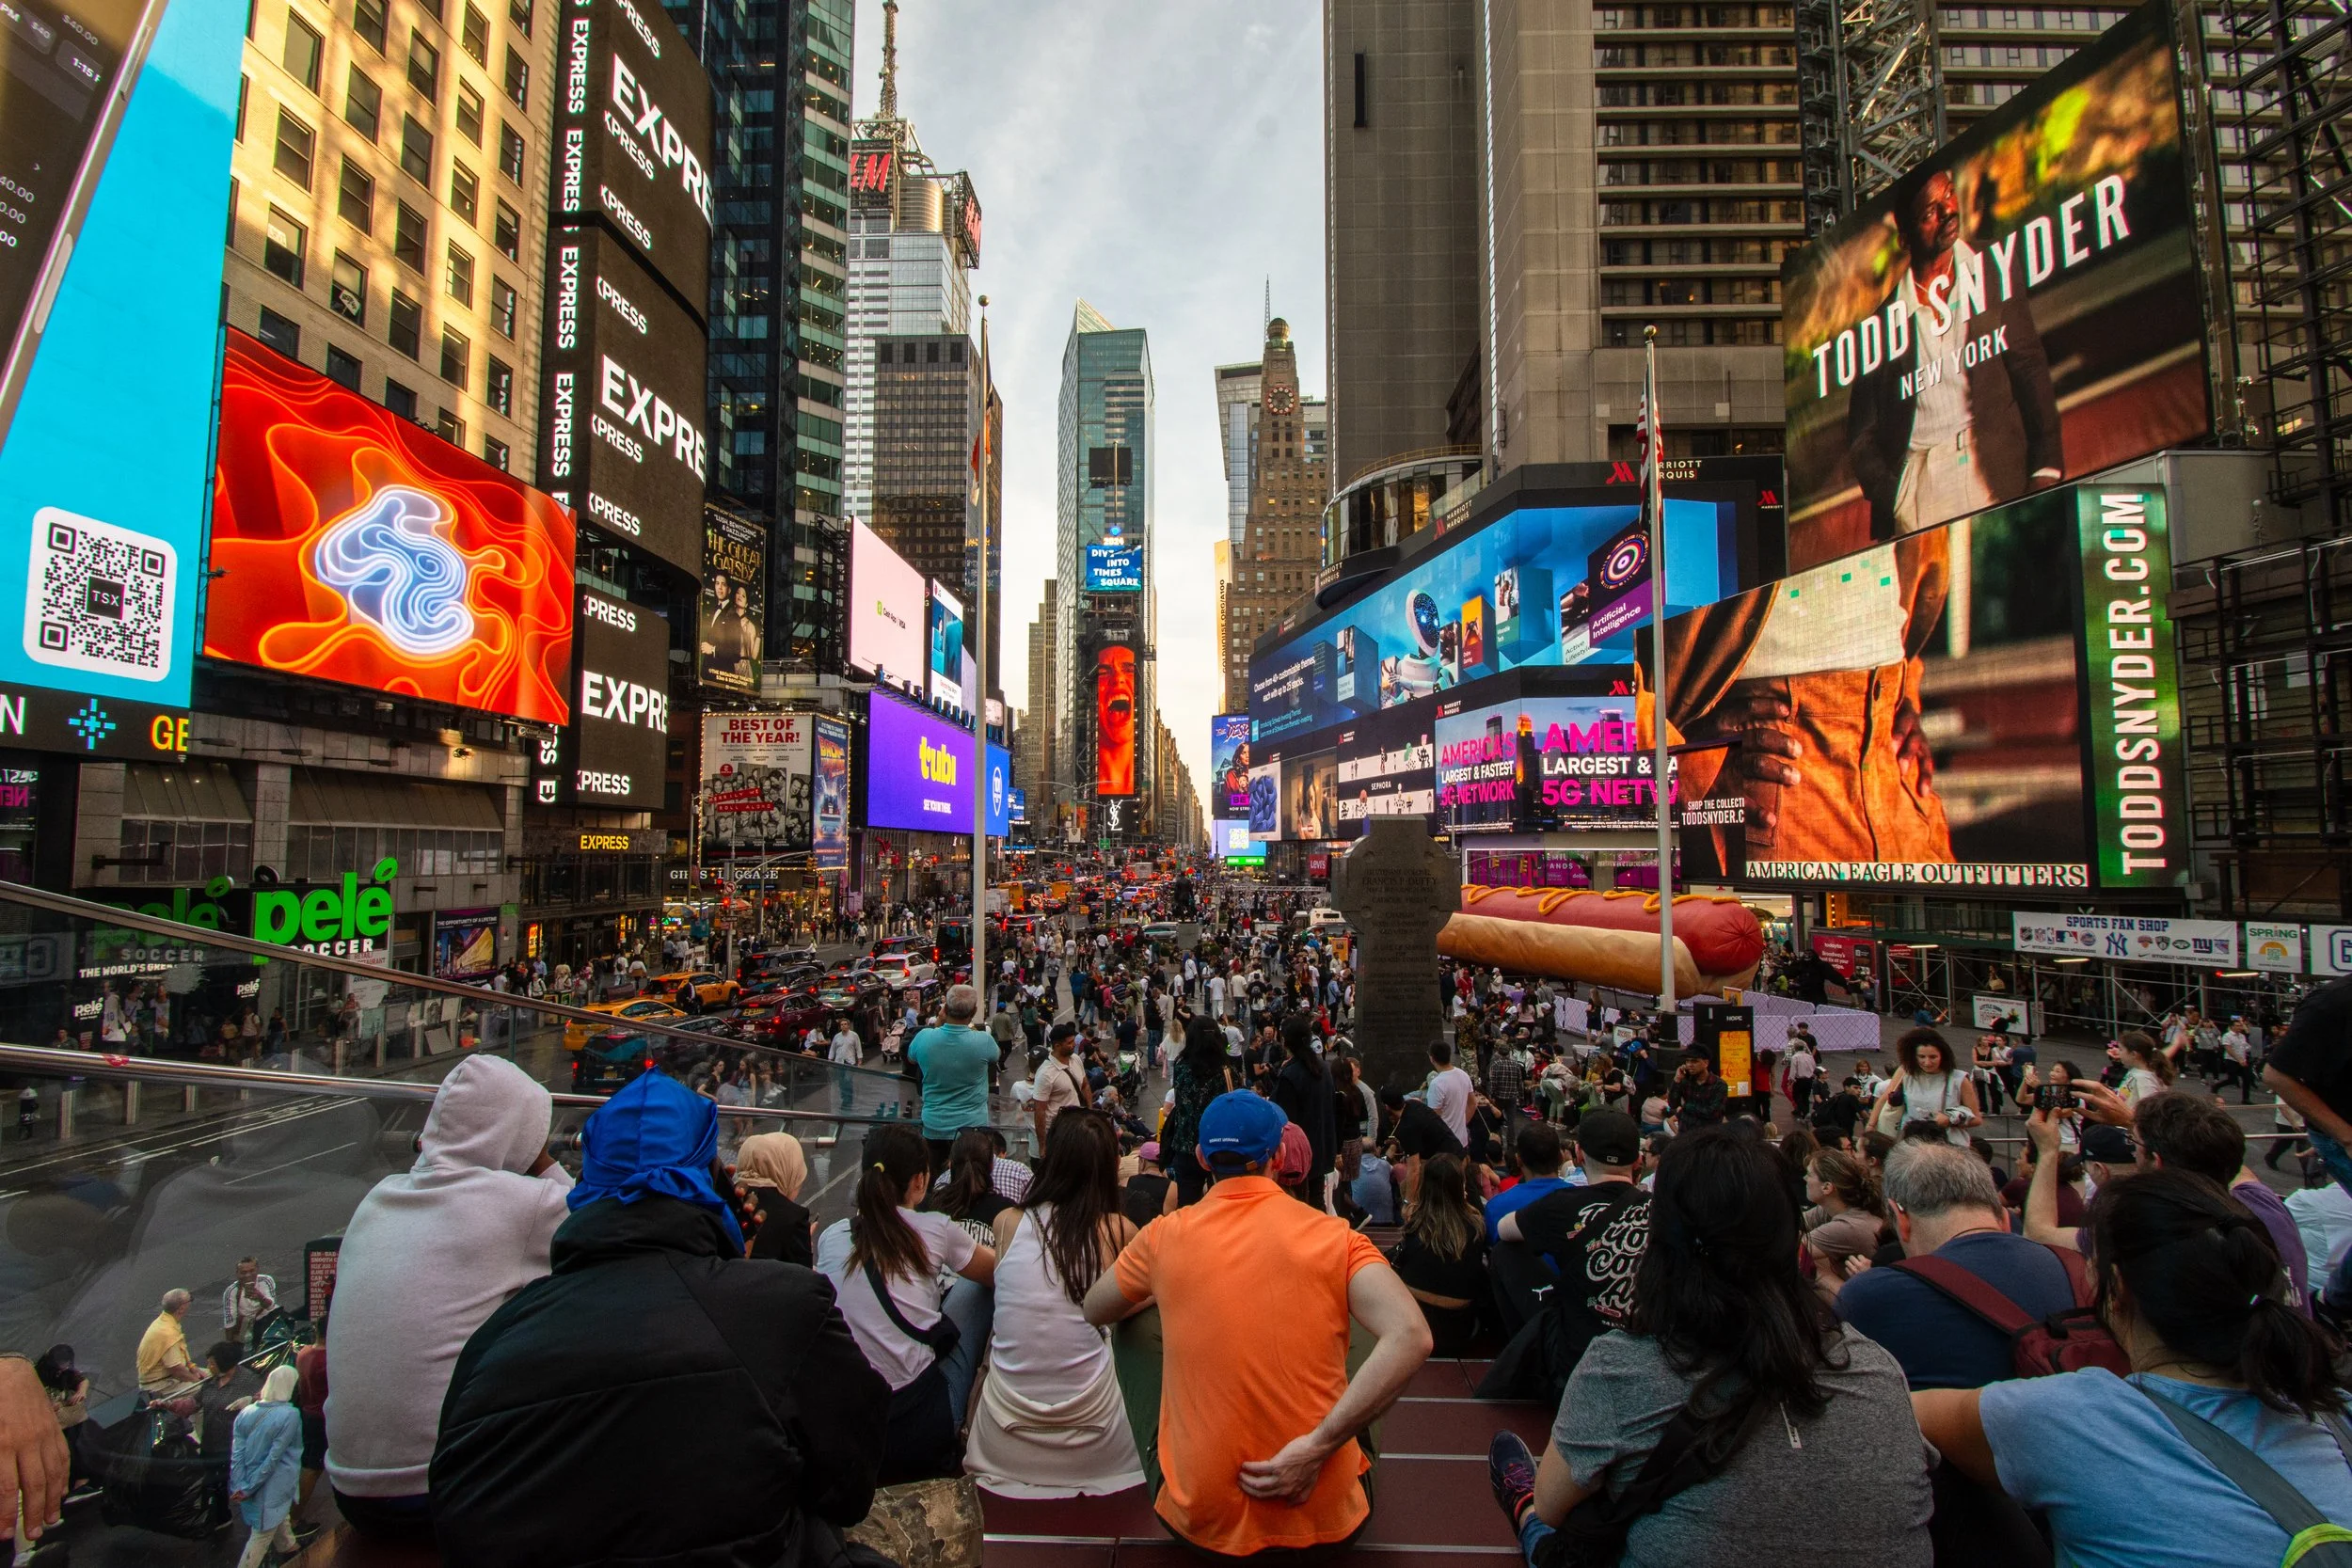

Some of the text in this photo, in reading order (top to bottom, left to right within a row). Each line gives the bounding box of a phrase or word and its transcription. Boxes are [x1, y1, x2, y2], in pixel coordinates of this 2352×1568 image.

[31, 22, 51, 40] $40
[62, 14, 99, 46] $40.00
[72, 57, 93, 77] 1:15
[569, 19, 590, 114] EXPRESS
[563, 129, 582, 232] EXPRES
[1813, 174, 2131, 399] TODD SNYDER
[558, 246, 579, 348] EXPRESS
[1900, 325, 2009, 400] NEW YORK
[552, 373, 573, 477] EXPRESS
[1659, 459, 1702, 469] RRIOTT
[1659, 470, 1695, 479] RQUIS
[1446, 500, 1472, 521] MARRIOTT
[1446, 511, 1470, 531] MARQUIS
[1103, 537, 1124, 546] 2024
[1093, 568, 1122, 577] TIMES
[1106, 558, 1129, 567] INTO
[1100, 578, 1138, 586] SQUARE
[92, 590, 121, 607] TSX
[1592, 602, 1627, 629] Artificial
[1593, 606, 1641, 639] Intelligence
[1565, 641, 1585, 656] Active
[2100, 494, 2168, 876] TODDSNYDER.COM
[728, 718, 795, 731] BEST OF
[721, 732, 801, 743] THE YEAR!
[1440, 731, 1516, 768] AMERICA'S
[919, 736, 956, 786] tubi
[1543, 756, 1652, 775] LARGEST &
[1441, 760, 1515, 784] LARGEST & FASTEST
[1371, 781, 1392, 790] SEPHORA
[1439, 779, 1516, 807] 5G NETWORK
[1542, 780, 1581, 806] 5G
[1688, 800, 1703, 811] SHOP
[1704, 799, 1715, 809] THE
[1681, 809, 1745, 826] TODDSNYDER.C
[580, 834, 629, 850] EXPRESS
[670, 870, 779, 879] GIS LGGAGE
[1747, 861, 2087, 887] AMERICAN EAGLE OUTFITTERS
[252, 857, 398, 966] pelé
[2066, 915, 2169, 932] SPORTS FAN SHOP
[2106, 931, 2129, 957] NY
[120, 948, 204, 962] SOCCER
[79, 963, 146, 978] THE WORLD'S
[237, 978, 260, 995] pelé
[74, 997, 103, 1017] pelé
